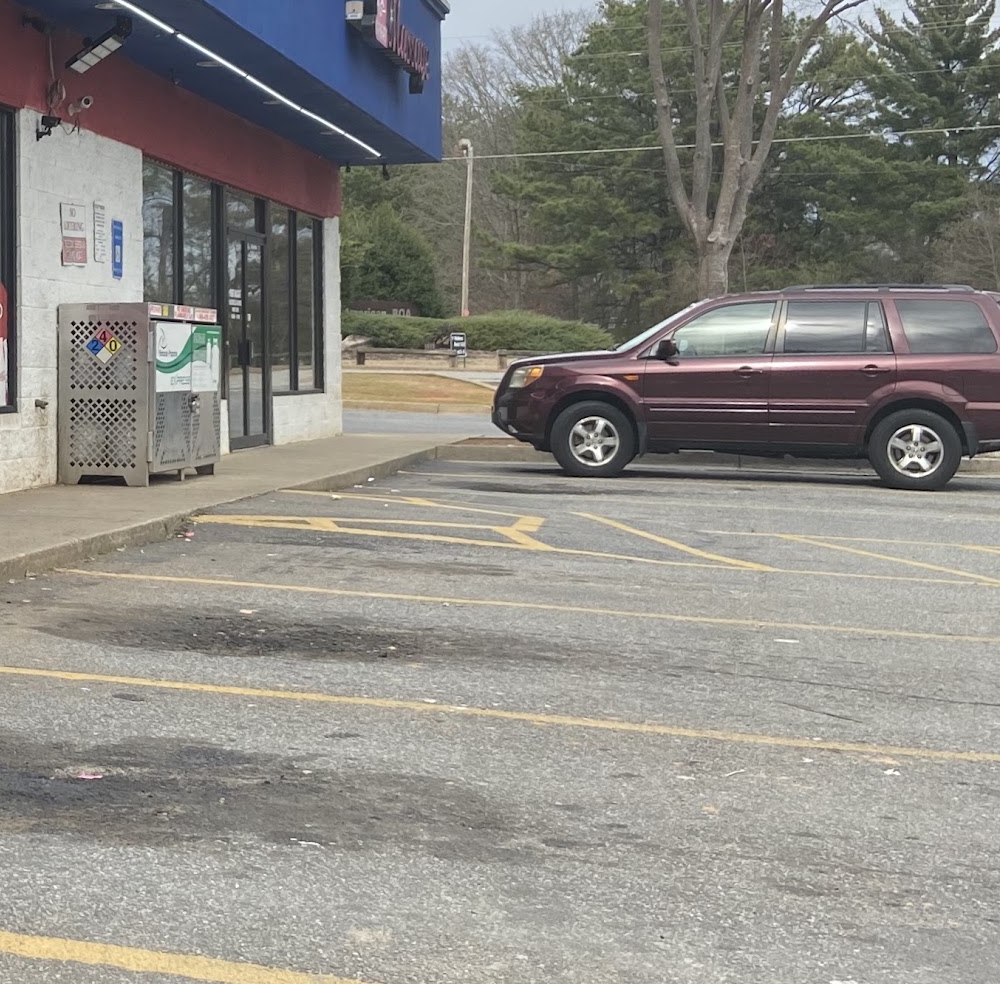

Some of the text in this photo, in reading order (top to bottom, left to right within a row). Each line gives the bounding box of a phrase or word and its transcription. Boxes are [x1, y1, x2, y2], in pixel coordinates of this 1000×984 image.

[99, 330, 107, 343] 4
[91, 339, 99, 351] 2
[109, 339, 118, 352] 0
